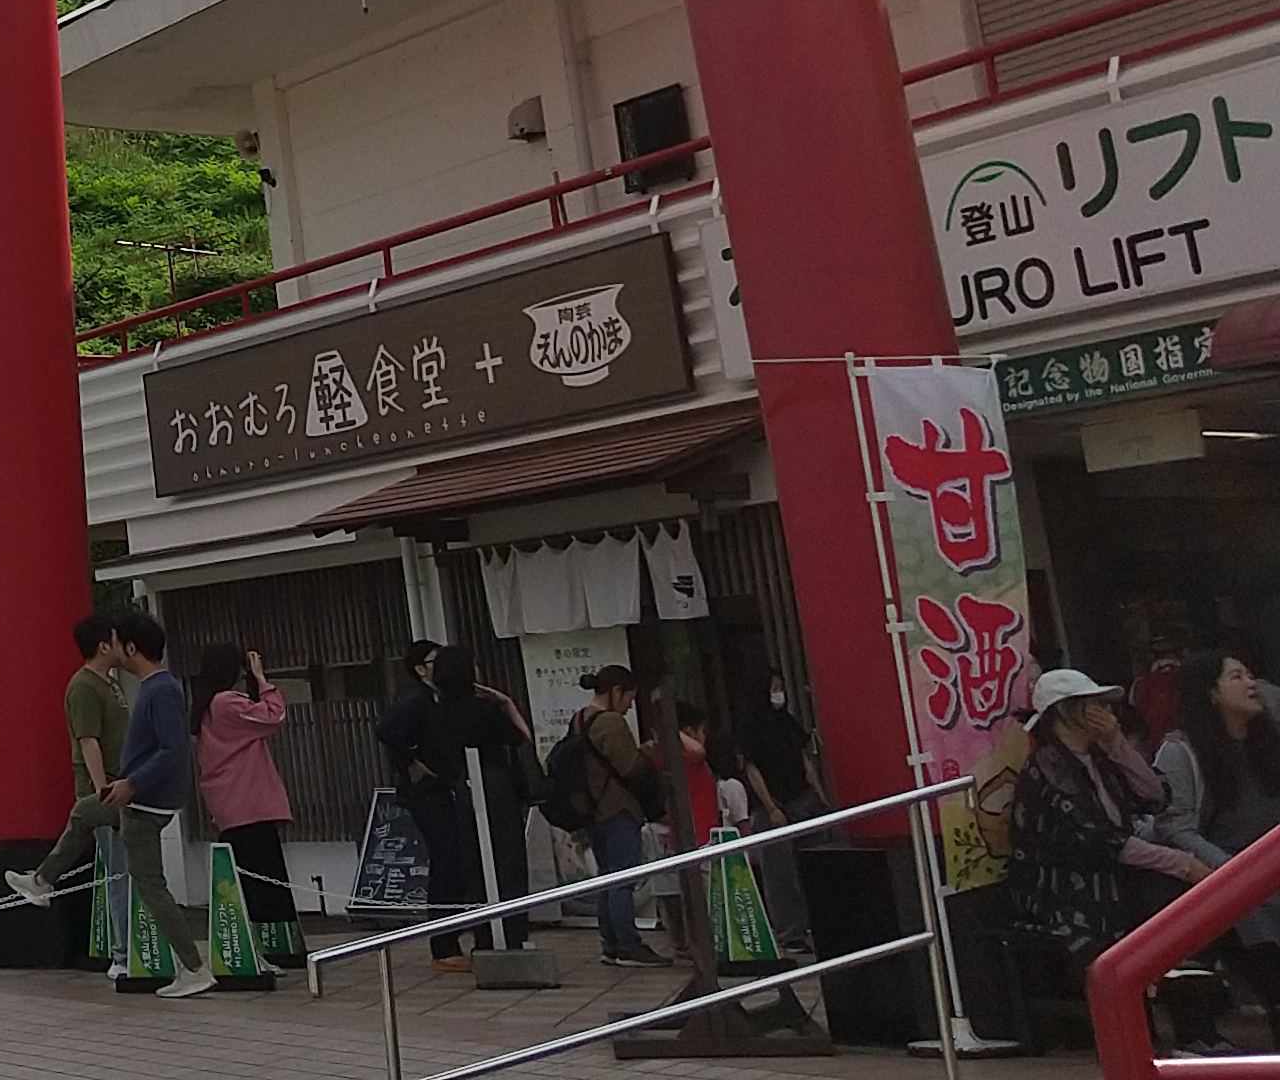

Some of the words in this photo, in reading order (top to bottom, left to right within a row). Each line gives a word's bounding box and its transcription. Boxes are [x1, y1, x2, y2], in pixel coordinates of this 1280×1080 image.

[960, 195, 1035, 247] 登山
[1056, 96, 1273, 219] リフト
[1075, 219, 1210, 297] LIFT
[536, 314, 626, 370] えんのかま
[557, 302, 593, 325] 陶芸
[170, 335, 449, 454] おおむろ軽食堂
[1002, 393, 1063, 413] Designated
[1066, 390, 1080, 402] by
[1084, 387, 1102, 398] the
[1109, 376, 1158, 395] National
[885, 406, 1025, 731] 甘酒
